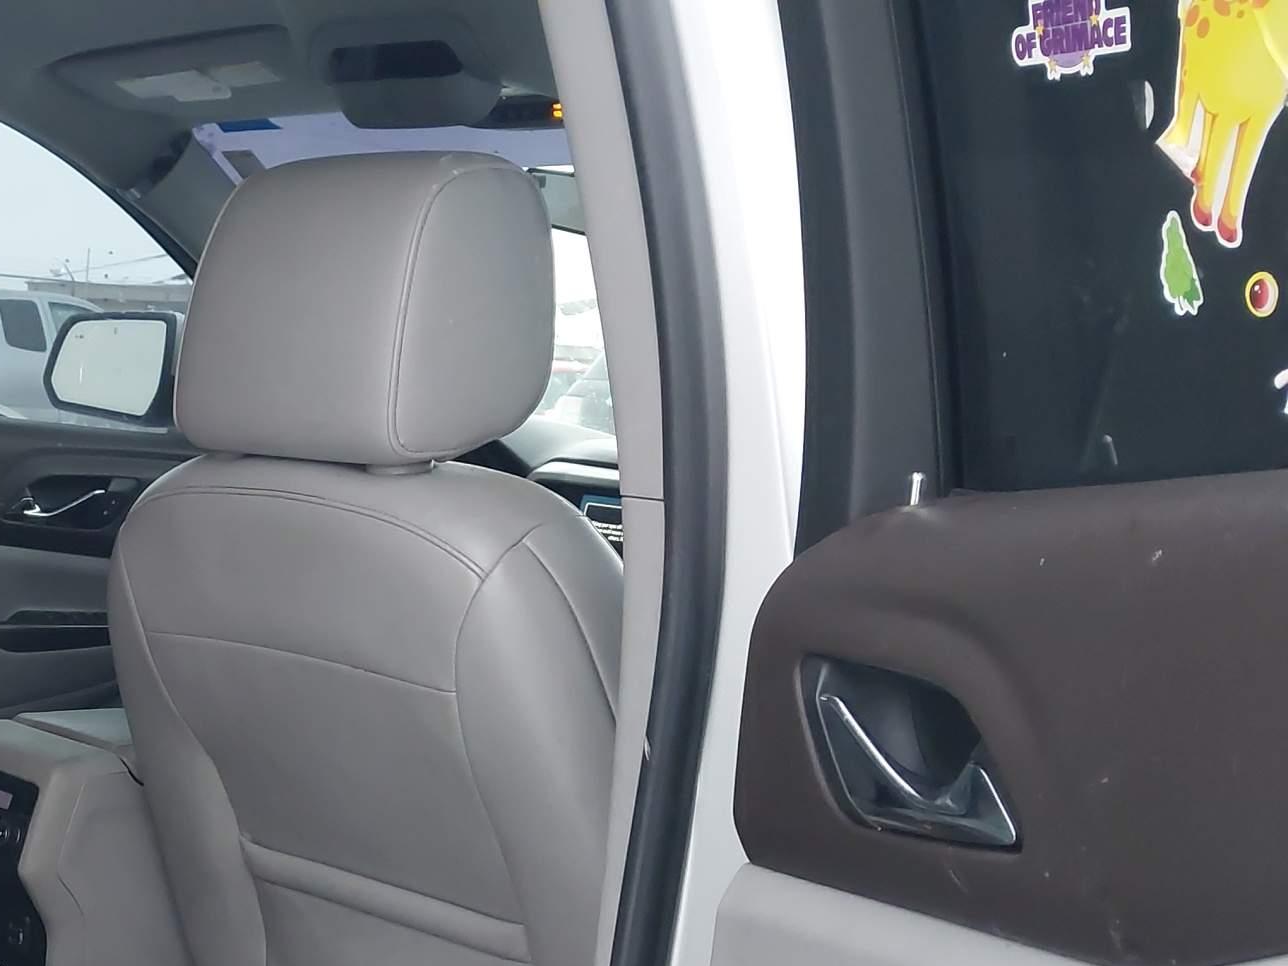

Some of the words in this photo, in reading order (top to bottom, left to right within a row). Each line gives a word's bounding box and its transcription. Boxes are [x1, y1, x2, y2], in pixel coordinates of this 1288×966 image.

[1031, 0, 1101, 28] FRIEND
[1014, 32, 1037, 60] OF
[1039, 16, 1127, 57] GRIMACE
